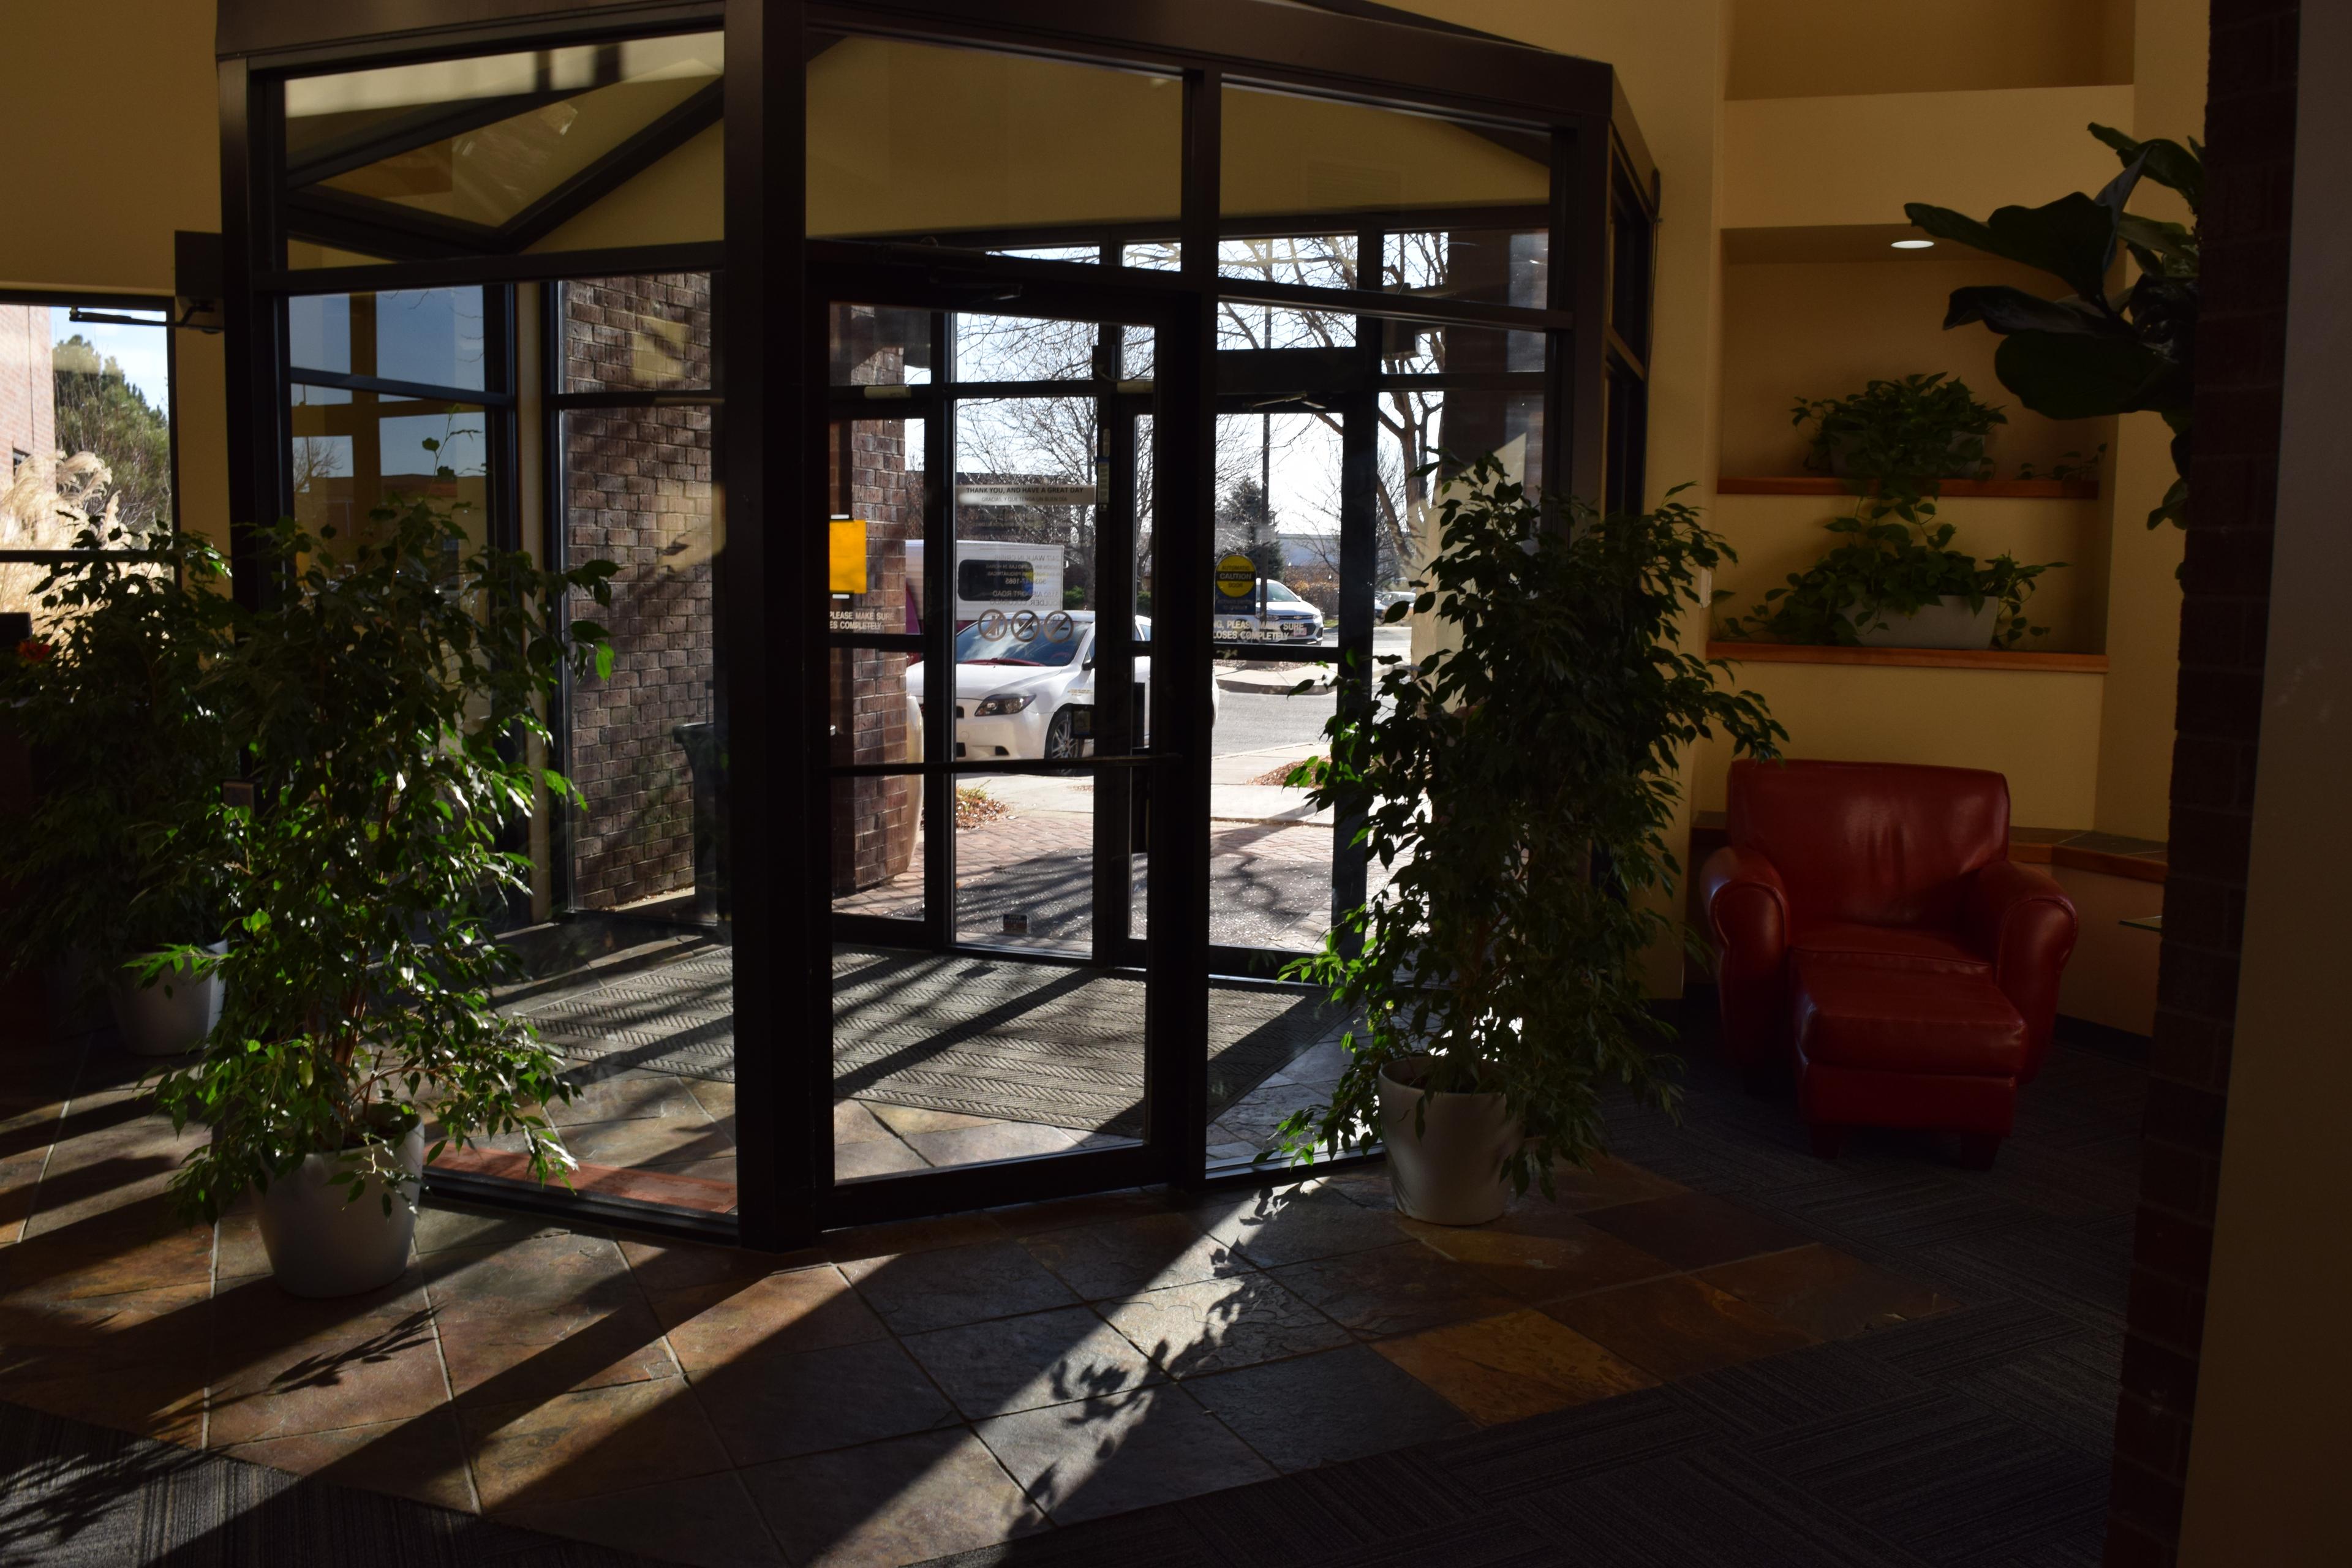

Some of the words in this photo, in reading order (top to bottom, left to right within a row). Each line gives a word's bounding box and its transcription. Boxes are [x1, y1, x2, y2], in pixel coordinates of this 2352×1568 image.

[829, 611, 853, 620] PLEASE
[855, 612, 875, 620] MAKE
[876, 612, 895, 621] SURE
[1227, 620, 1254, 630] PLEAS
[1283, 622, 1304, 631] SURE
[1240, 630, 1289, 641] COMPLETELY
